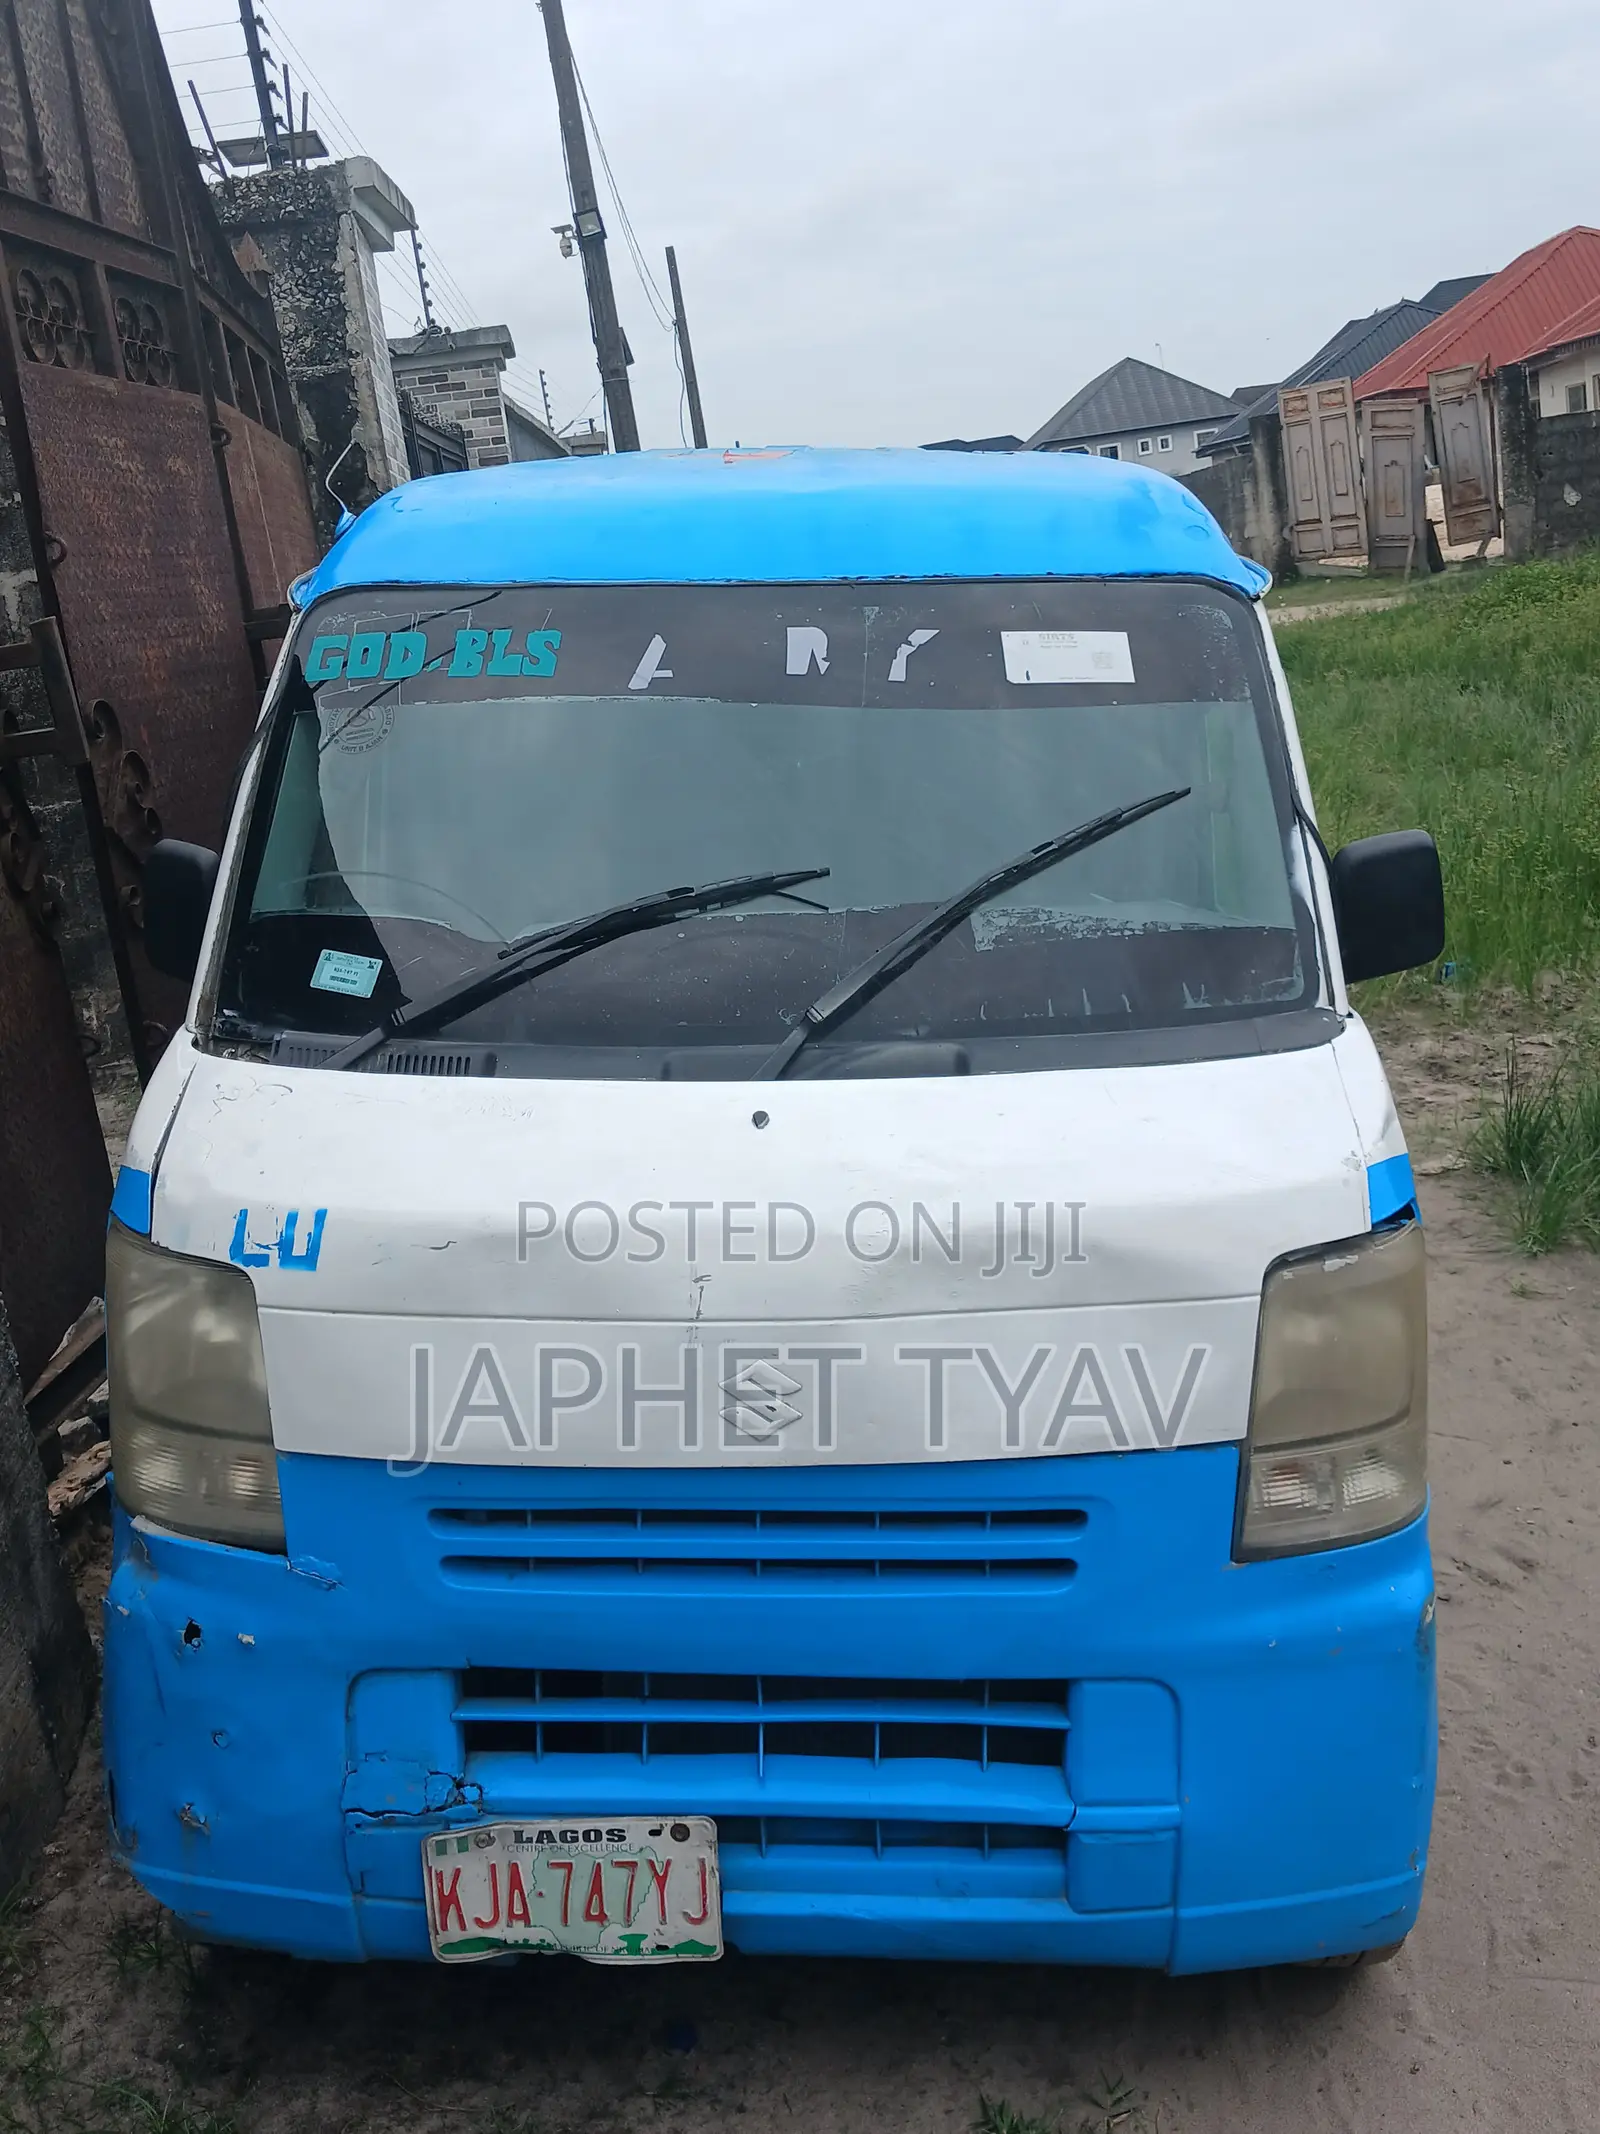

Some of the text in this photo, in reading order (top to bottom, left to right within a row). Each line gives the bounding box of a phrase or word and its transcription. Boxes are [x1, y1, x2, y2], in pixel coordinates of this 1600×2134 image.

[513, 1828, 627, 1844] LAGOS
[506, 1844, 548, 1854] CENTRE
[567, 1843, 634, 1853] EXCELLENCE
